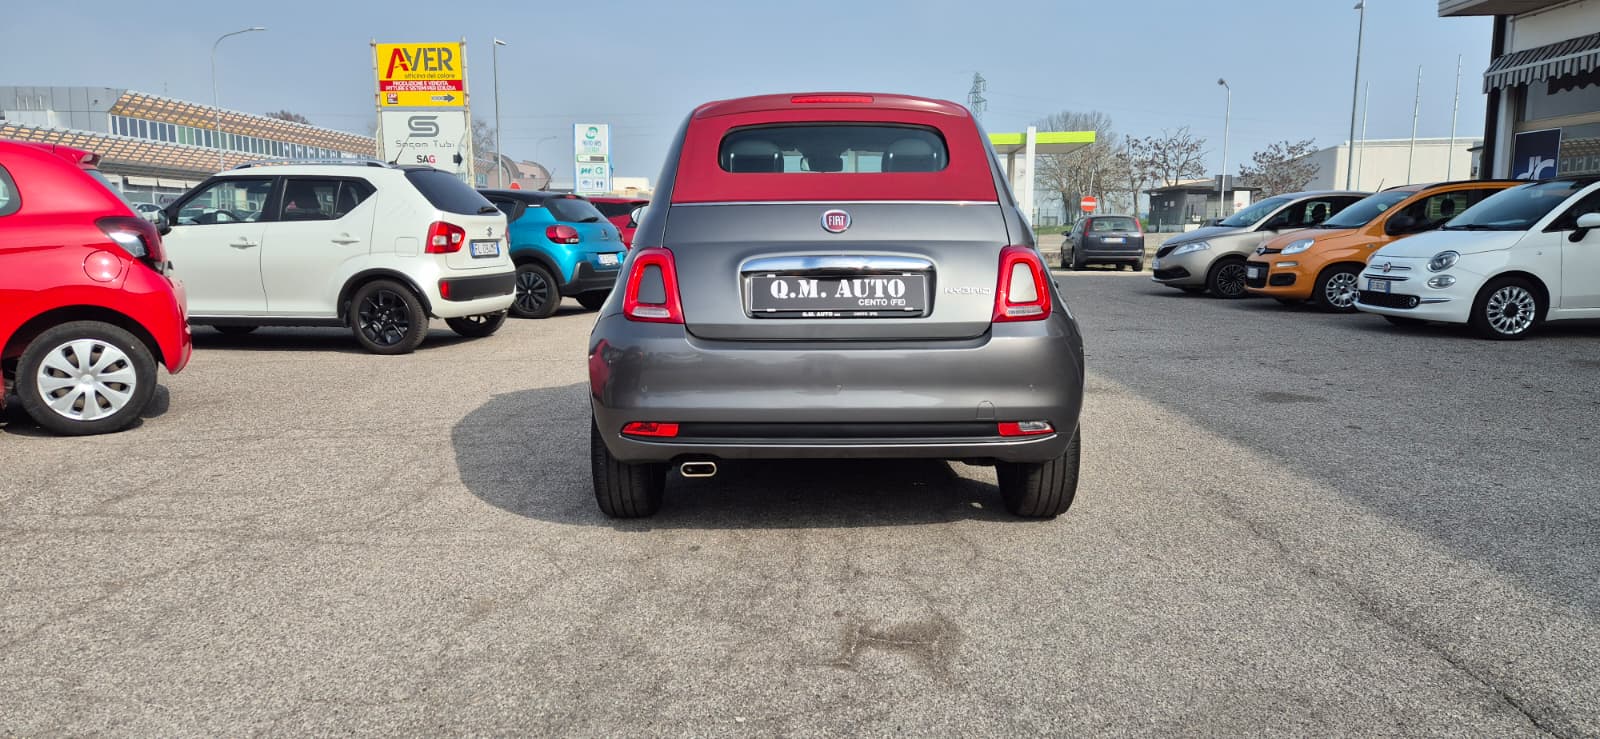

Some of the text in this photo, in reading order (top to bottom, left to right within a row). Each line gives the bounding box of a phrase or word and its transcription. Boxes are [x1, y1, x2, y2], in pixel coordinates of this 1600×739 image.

[386, 47, 454, 79] AVER
[431, 140, 455, 148] Tubi
[416, 154, 436, 164] SAG
[828, 215, 845, 226] FIAT
[770, 279, 906, 299] Q.M. AUTO
[858, 298, 906, 307] CENTO (FE)
